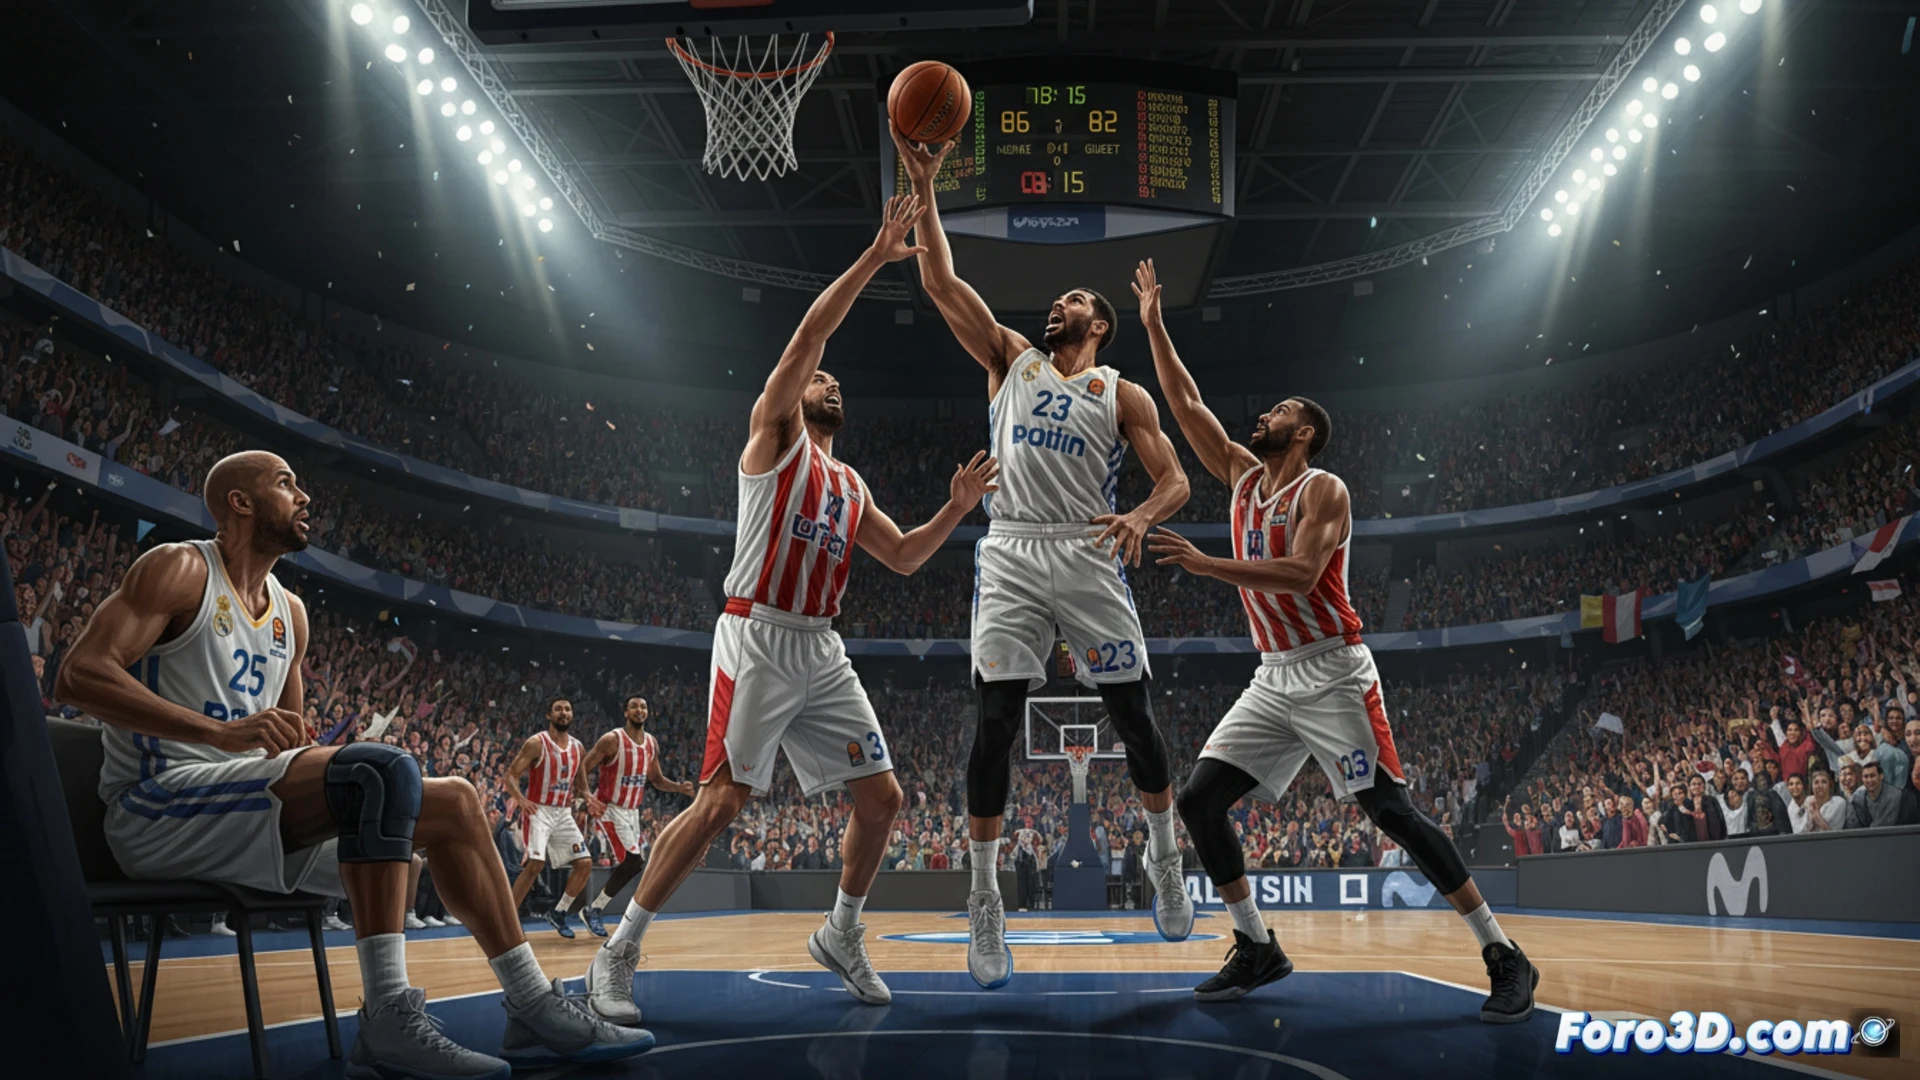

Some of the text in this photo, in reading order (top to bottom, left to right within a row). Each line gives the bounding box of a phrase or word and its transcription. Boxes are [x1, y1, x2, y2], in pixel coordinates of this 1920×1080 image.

[1066, 85, 1086, 105] 15
[1001, 110, 1030, 133] 86
[1089, 110, 1118, 133] 82
[1064, 171, 1084, 193] 15
[1032, 390, 1073, 422] 23
[1101, 640, 1137, 672] 23
[228, 648, 268, 697] 25
[866, 731, 885, 761] 3
